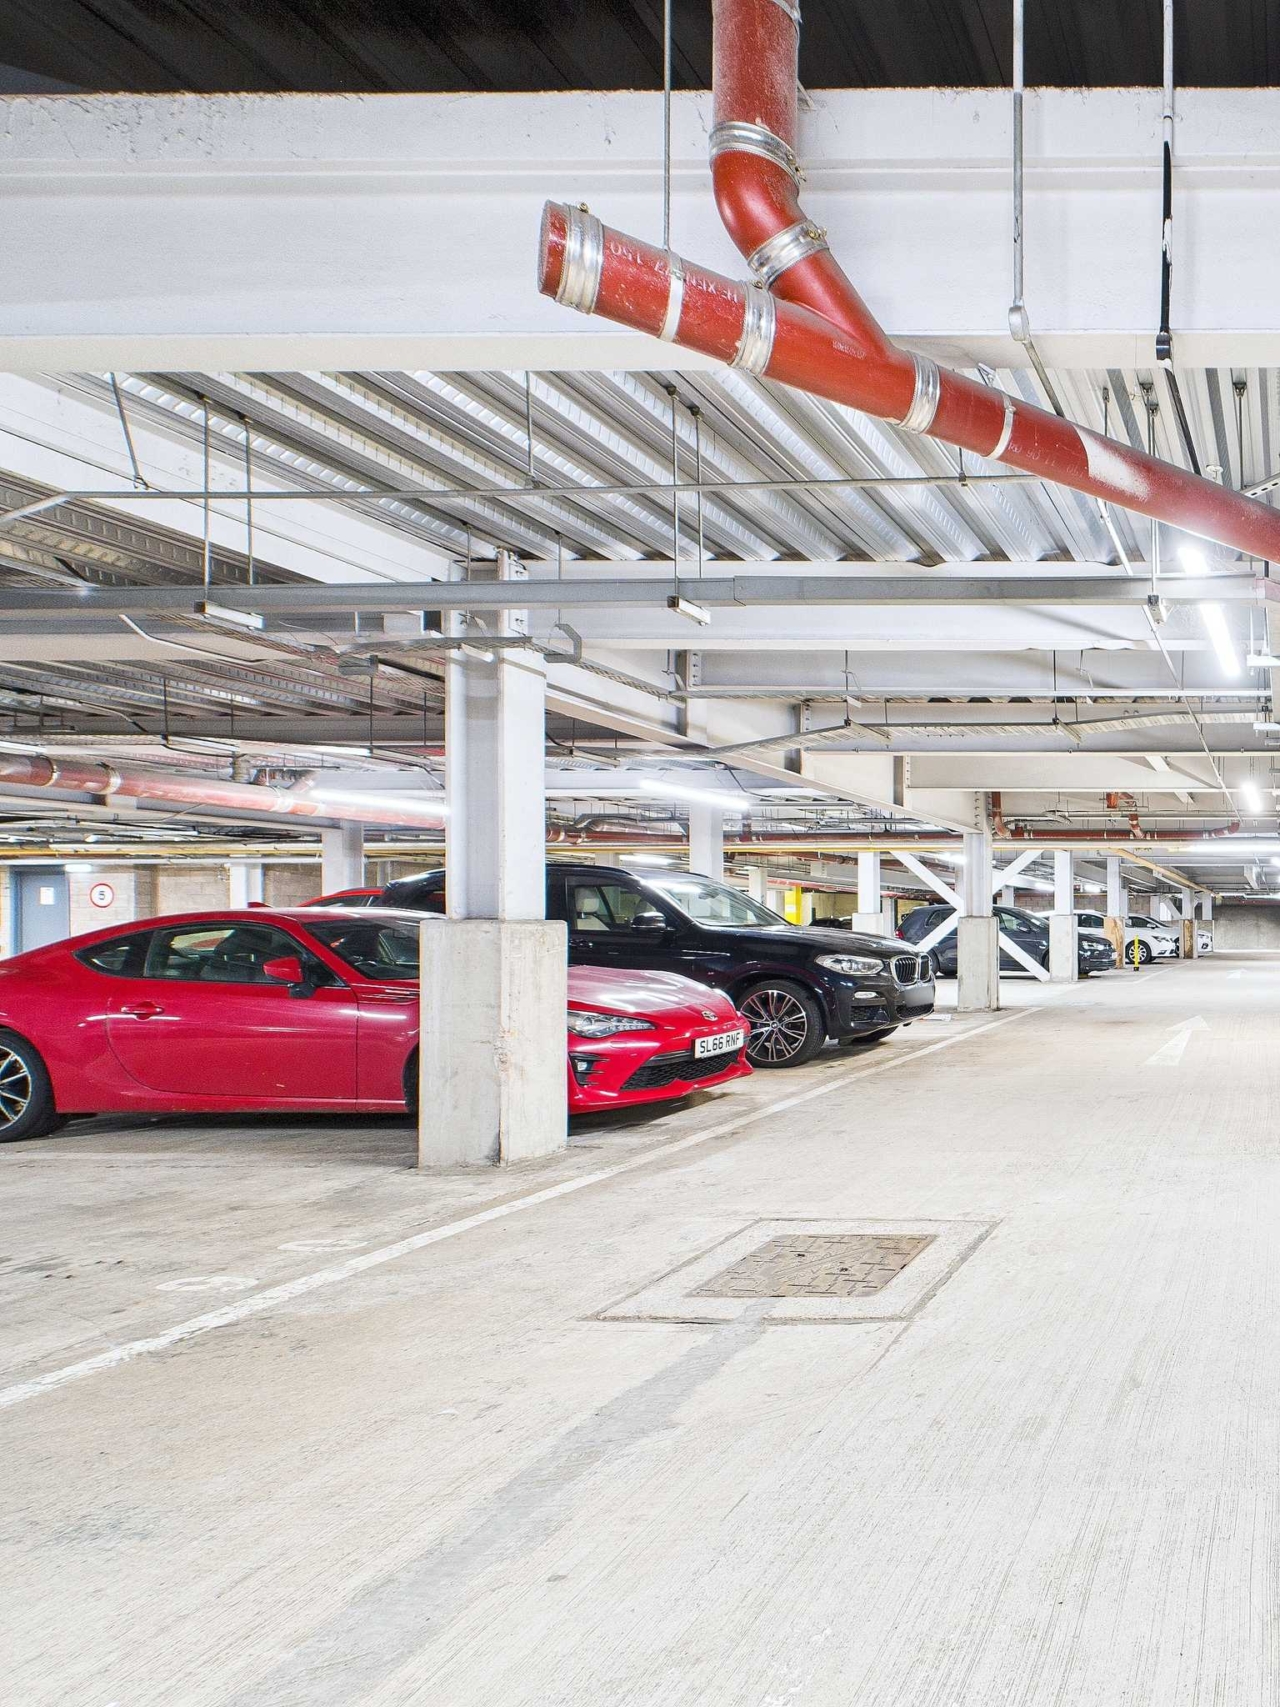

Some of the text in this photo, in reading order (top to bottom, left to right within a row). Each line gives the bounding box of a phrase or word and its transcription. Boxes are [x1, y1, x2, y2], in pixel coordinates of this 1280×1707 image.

[98, 890, 106, 901] 5
[700, 1032, 740, 1054] SL66 RNF
